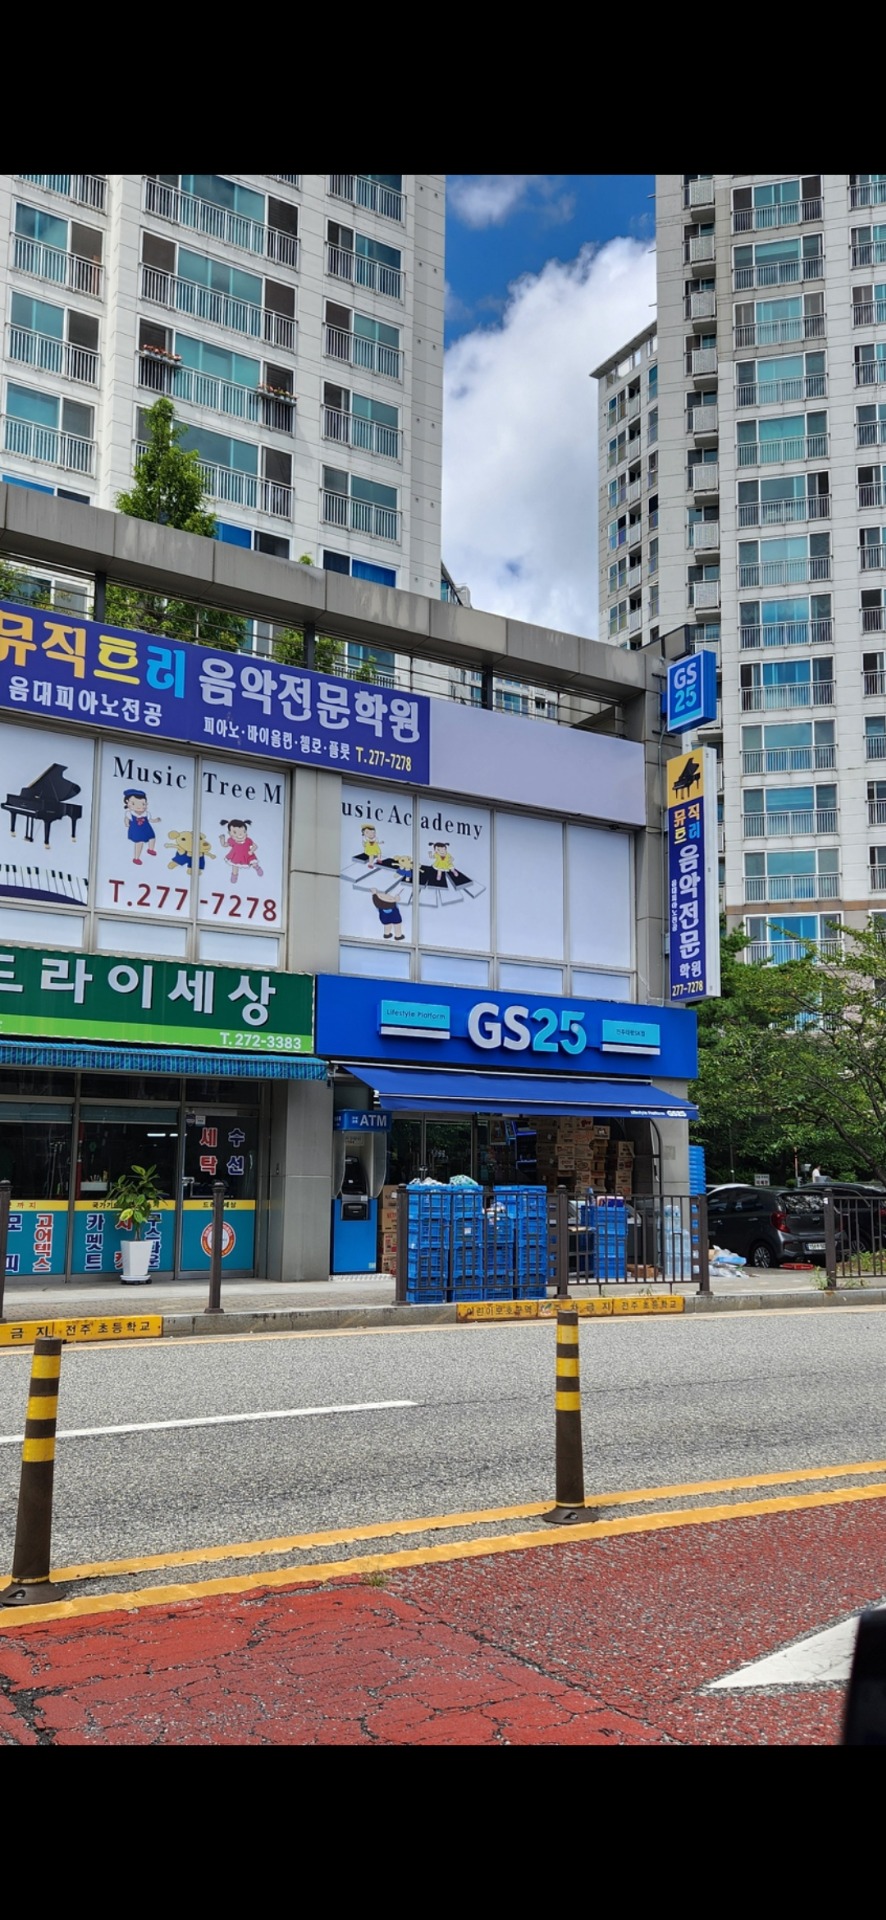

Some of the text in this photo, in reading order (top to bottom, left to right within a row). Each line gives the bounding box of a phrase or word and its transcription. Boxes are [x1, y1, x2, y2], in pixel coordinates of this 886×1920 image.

[673, 662, 698, 690] GS
[8, 675, 163, 727] 음대피아노전공
[198, 657, 421, 744] 음악전문학원
[674, 683, 698, 713] 25
[113, 756, 187, 789] Music
[203, 772, 256, 800] Tree
[671, 980, 704, 997] 277-7278
[386, 1008, 446, 1020] Lifestyle Platform
[467, 1002, 587, 1055] GS25
[359, 1114, 387, 1127] ATM
[32, 1213, 54, 1273] 고어텍스
[66, 1324, 91, 1336] 전주
[98, 1321, 150, 1334] 초등학교
